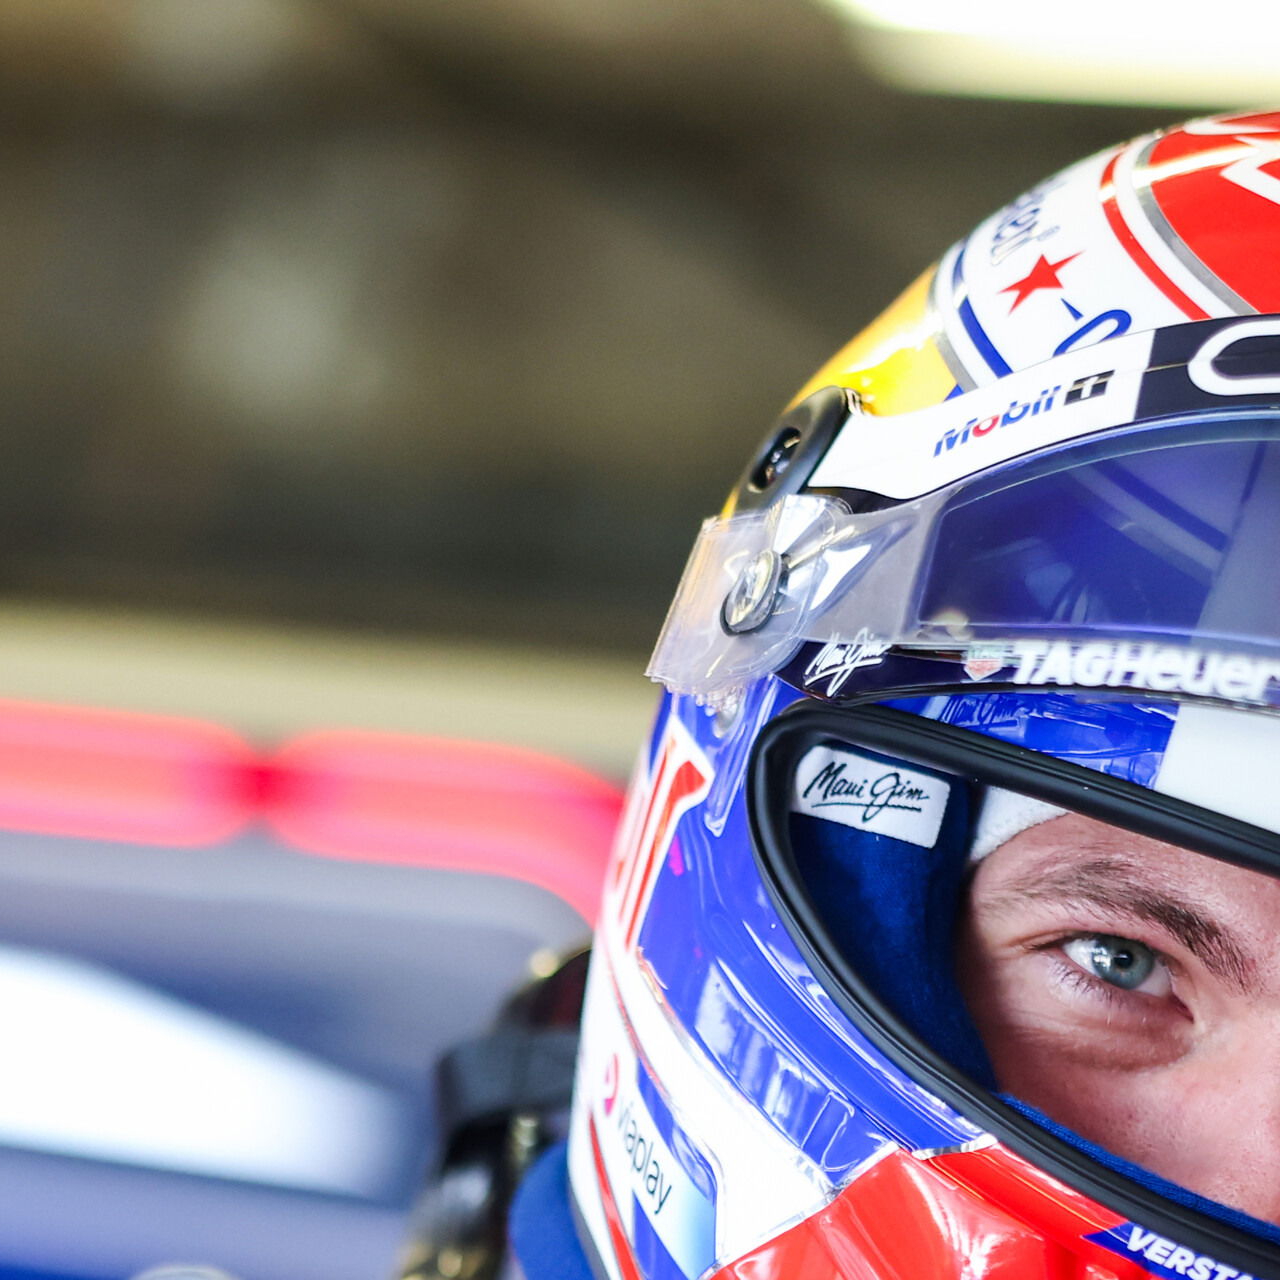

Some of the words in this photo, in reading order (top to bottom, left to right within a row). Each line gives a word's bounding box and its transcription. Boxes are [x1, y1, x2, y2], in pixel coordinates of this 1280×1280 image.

[932, 384, 1062, 458] Mobil
[802, 761, 869, 801] Maui
[861, 771, 930, 824] Jim
